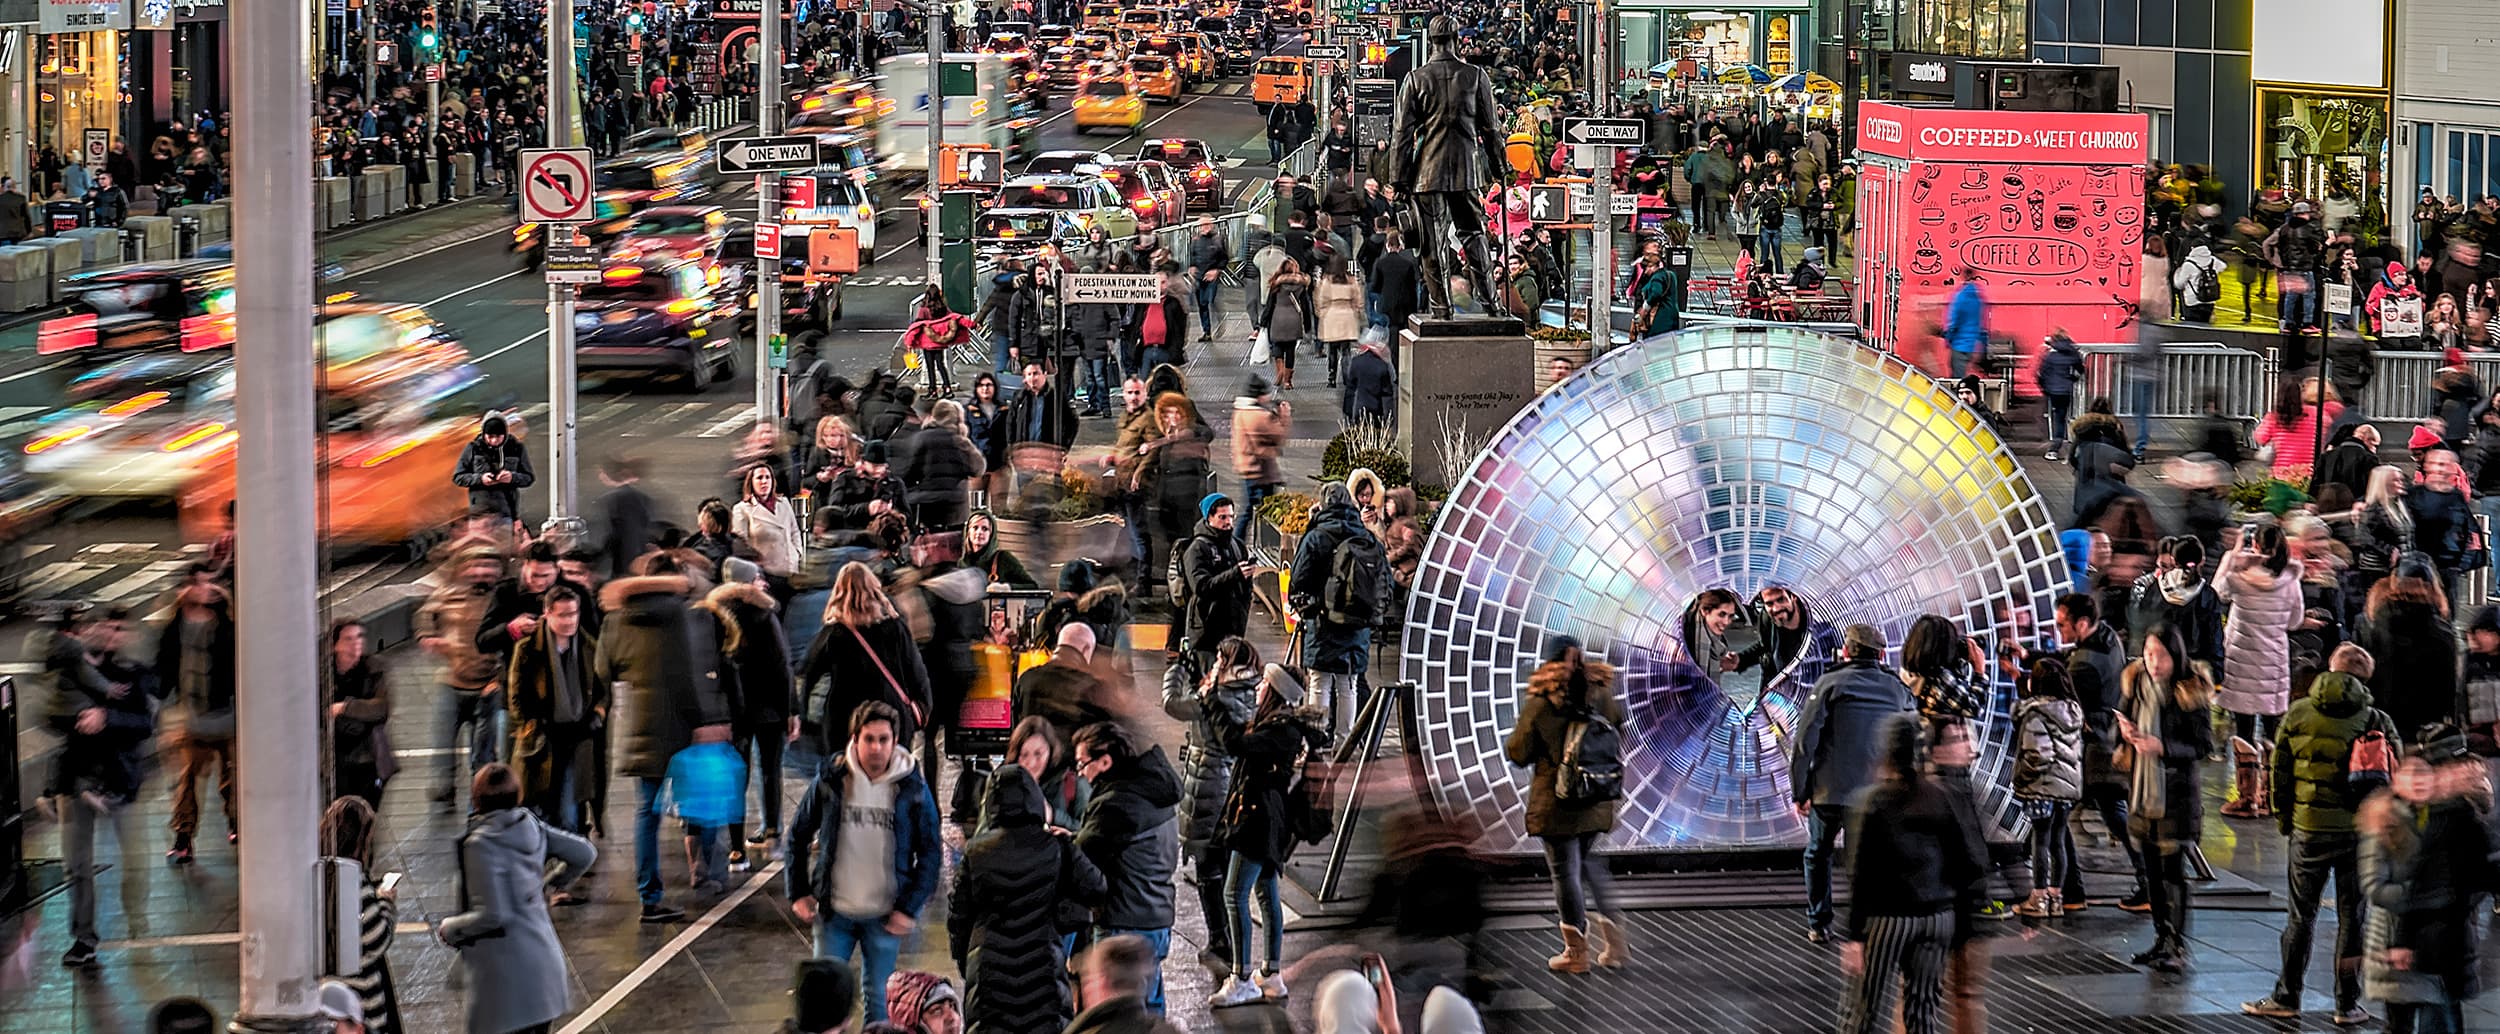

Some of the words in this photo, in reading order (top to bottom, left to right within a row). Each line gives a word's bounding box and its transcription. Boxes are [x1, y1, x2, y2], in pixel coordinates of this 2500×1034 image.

[1587, 126, 1609, 137] ONE
[1613, 127, 1635, 137] WAY
[1865, 116, 1902, 144] COFFEED
[1920, 127, 2023, 147] COFFEED
[2024, 134, 2032, 144] &
[2033, 129, 2076, 148] SWEET
[2079, 131, 2139, 149] CHURROS
[748, 147, 775, 161] ONE
[779, 146, 807, 160] WAY
[2048, 174, 2073, 196] Latte
[1950, 193, 1991, 208] Espresso
[569, 255, 593, 263] Square
[1971, 244, 2020, 266] COFFEE
[2027, 243, 2041, 266] &
[2047, 244, 2077, 266] TEA
[1074, 278, 1117, 287] PEDESTRIAN
[1118, 278, 1137, 287] FLOW
[1138, 278, 1156, 287] ZONE
[1111, 289, 1129, 299] KEEP
[1130, 289, 1157, 299] MOVING
